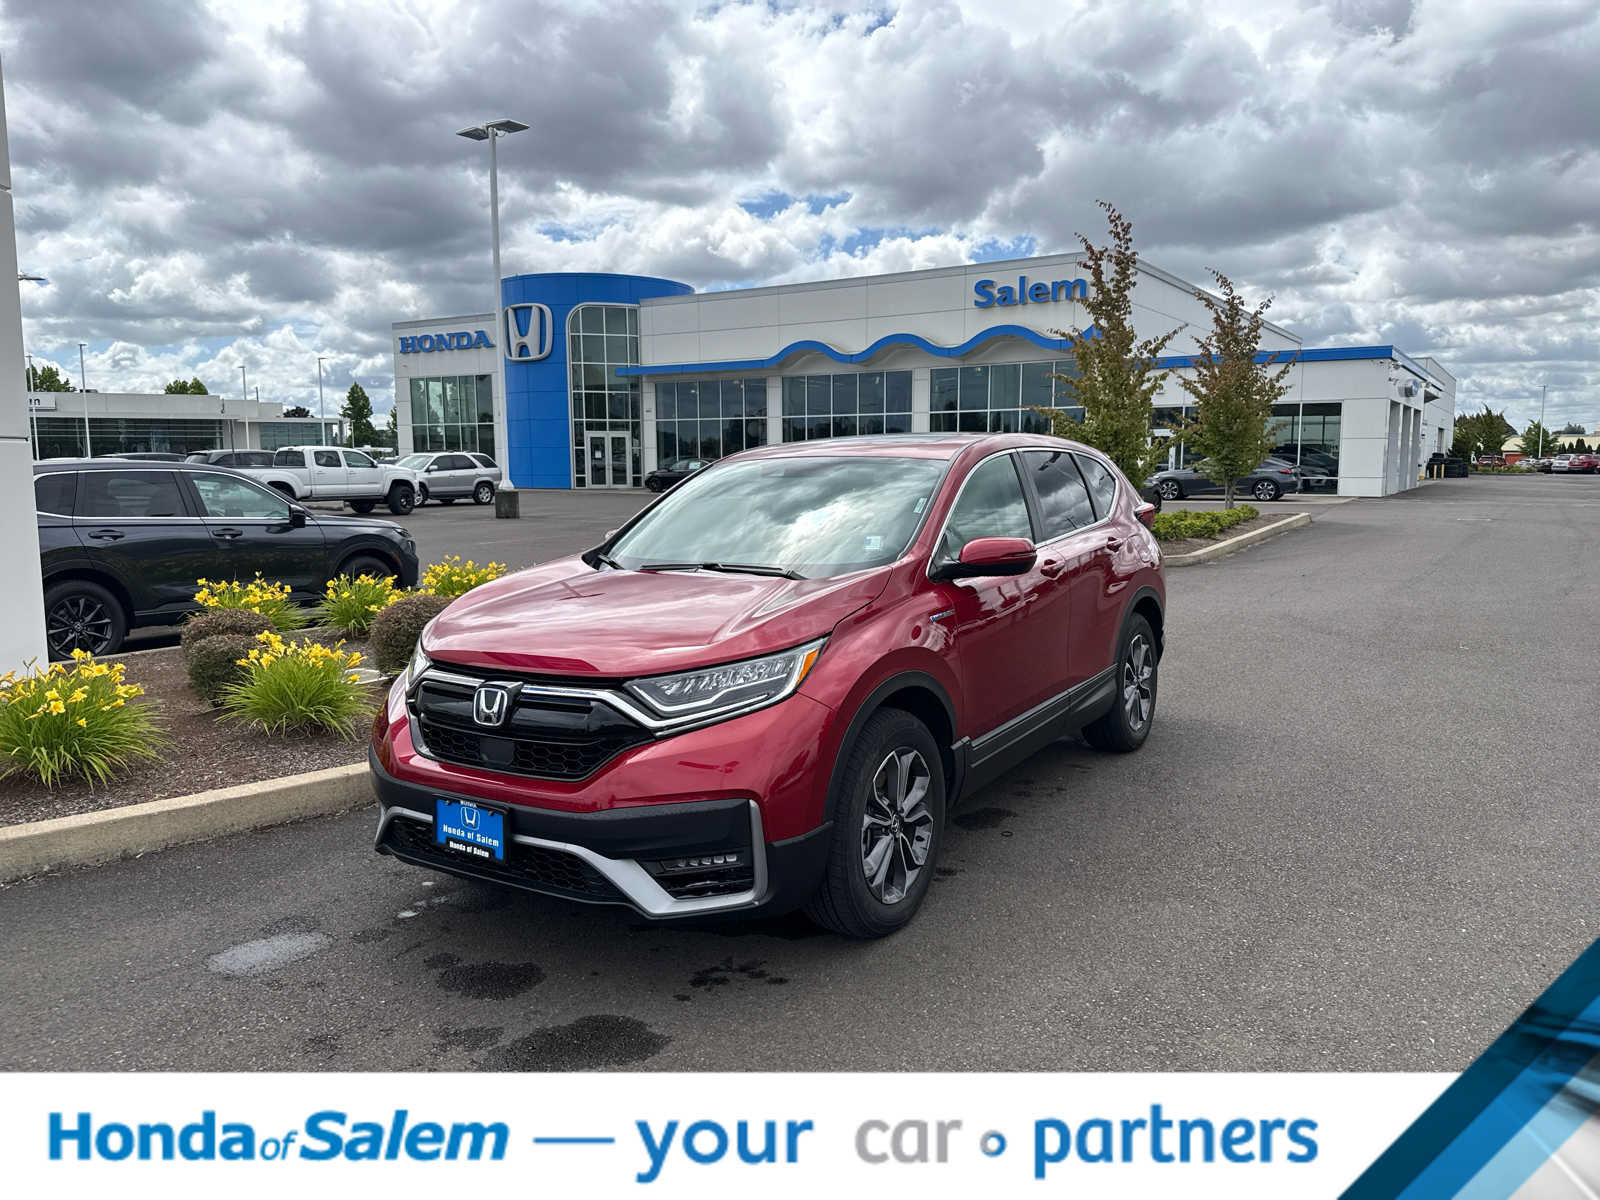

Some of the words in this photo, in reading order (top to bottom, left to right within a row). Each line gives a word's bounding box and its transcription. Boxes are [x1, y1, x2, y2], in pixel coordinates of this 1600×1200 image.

[974, 275, 1087, 307] Salem
[399, 330, 495, 354] HONDA
[443, 824, 465, 837] Honda
[467, 832, 474, 840] of
[476, 834, 499, 847] Salem
